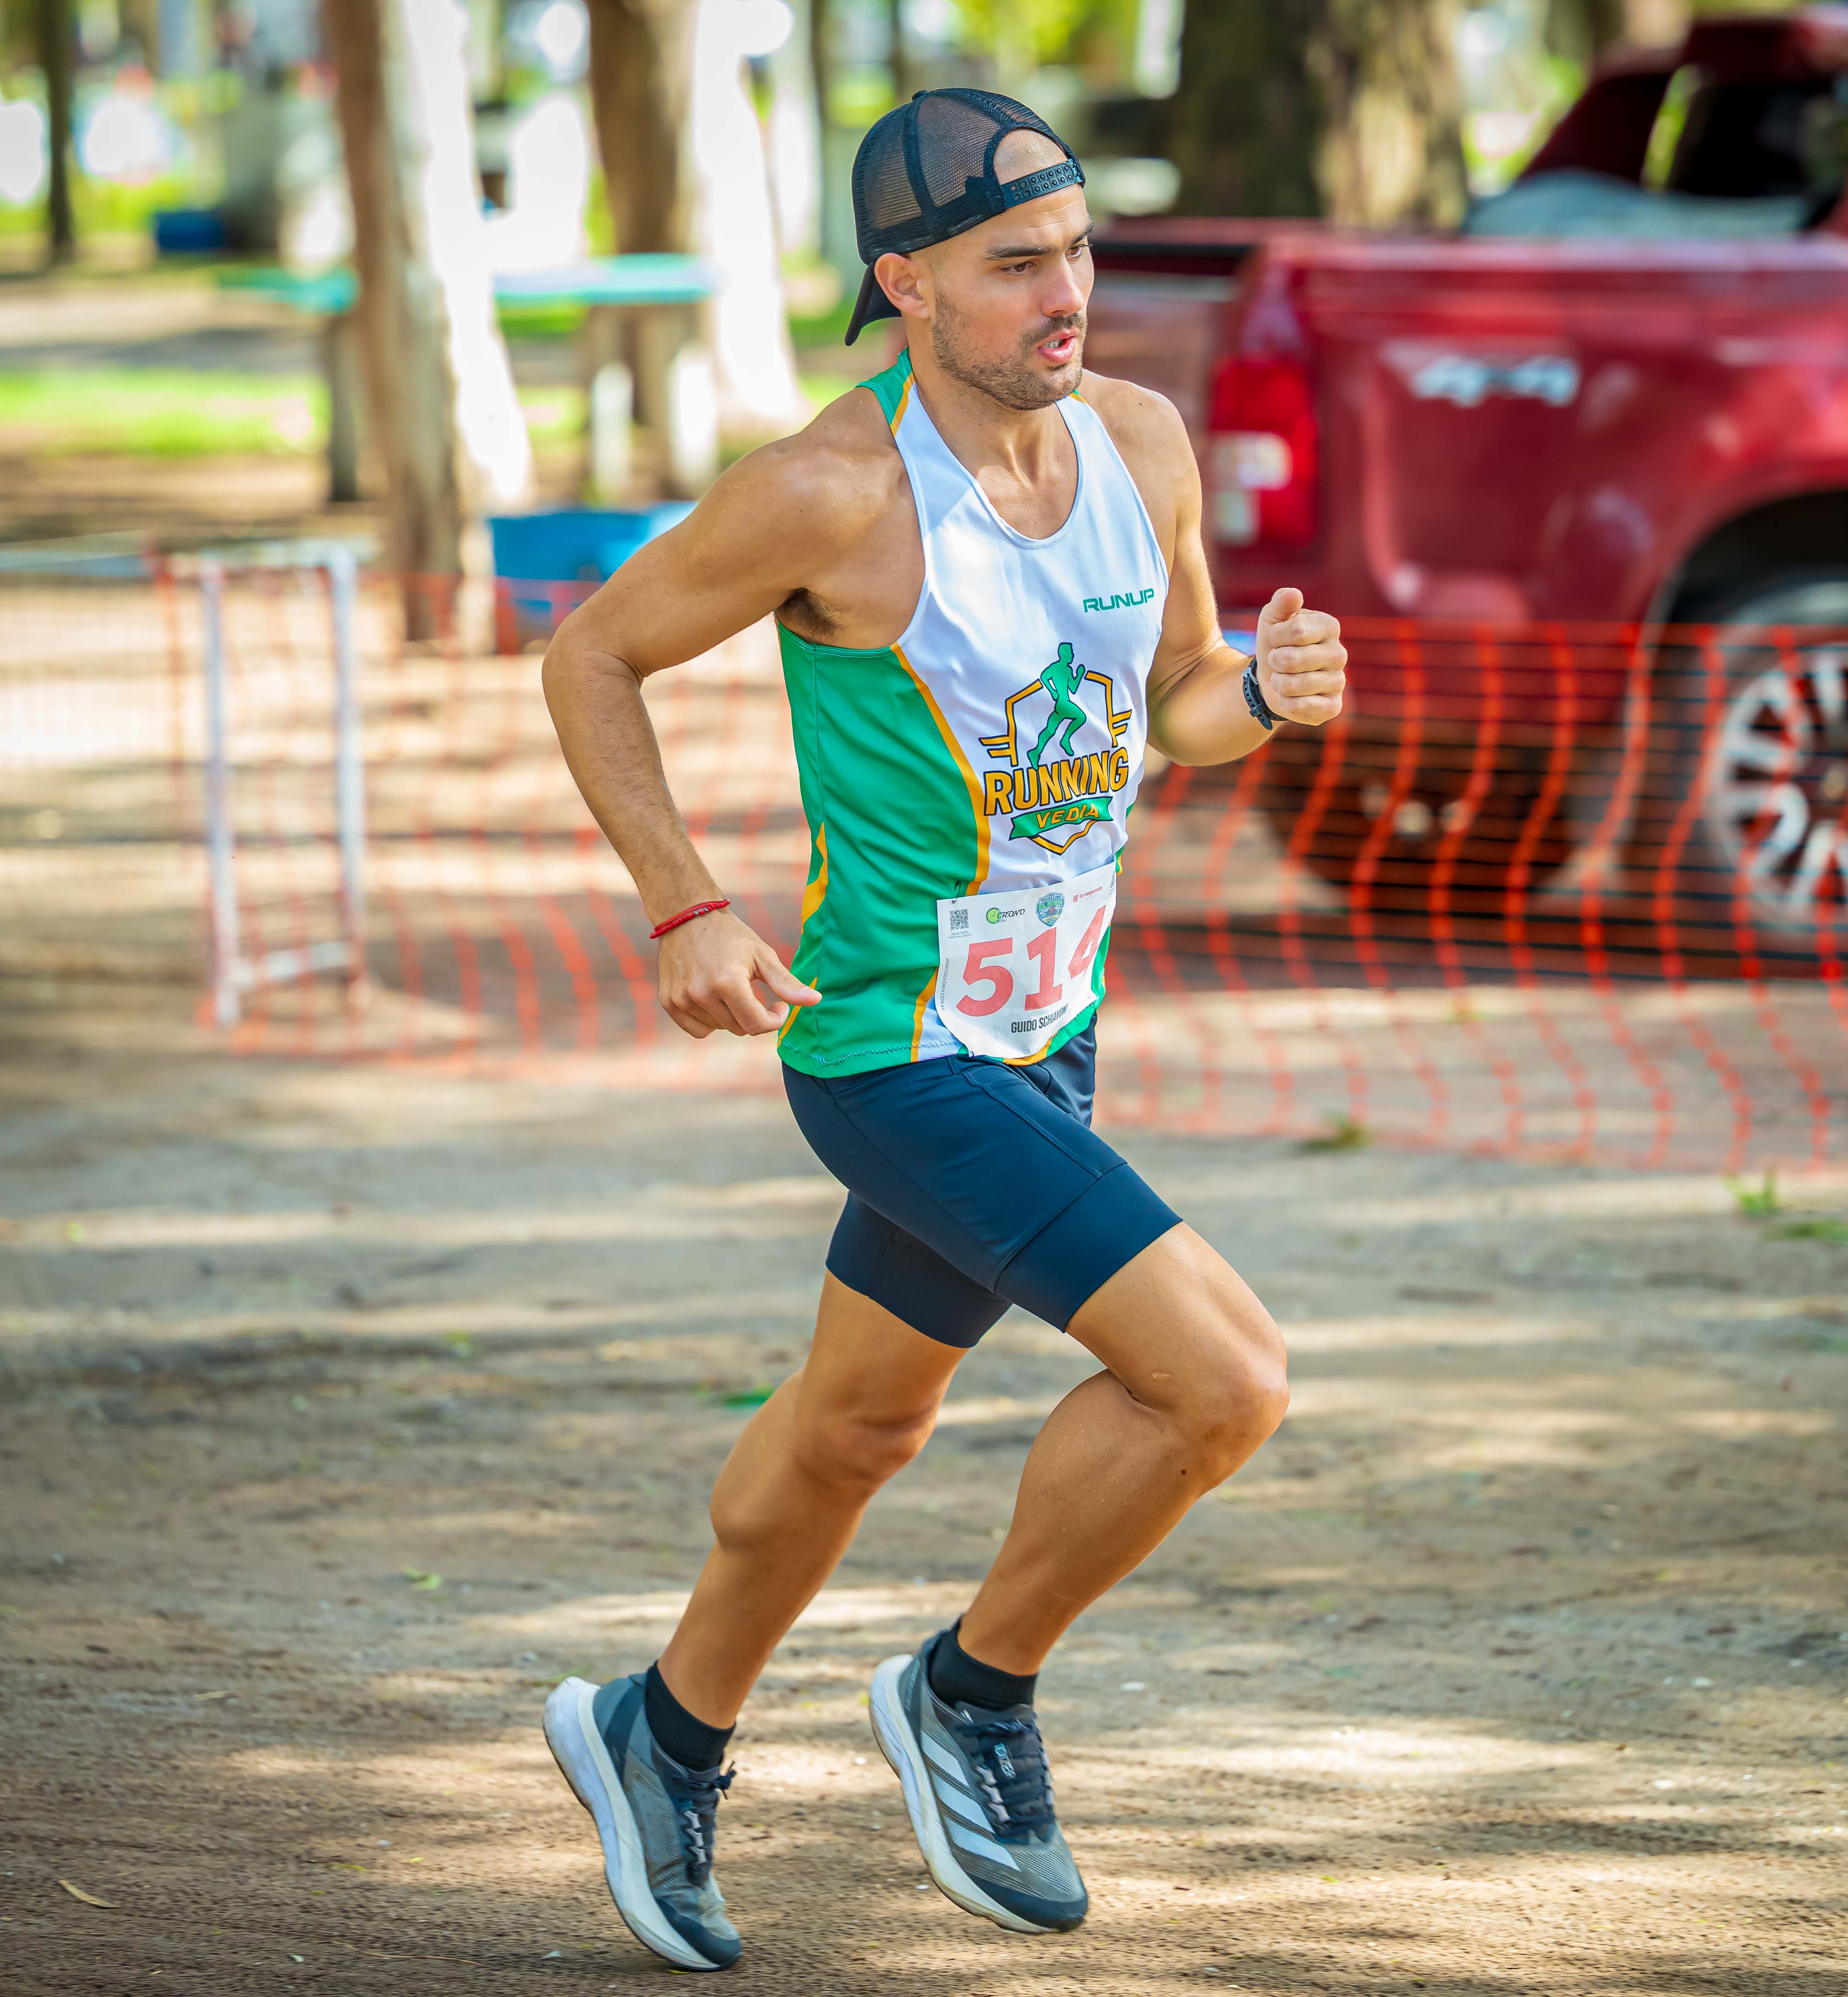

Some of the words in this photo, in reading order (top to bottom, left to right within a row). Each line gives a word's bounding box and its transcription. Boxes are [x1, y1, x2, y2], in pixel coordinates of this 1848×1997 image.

[1083, 588, 1154, 612] RUNUP
[983, 747, 1128, 816] RUNNING
[1036, 803, 1099, 828] VEDIA
[996, 909, 1025, 919] CRONO
[956, 905, 1106, 1016] 514
[1011, 1019, 1037, 1033] GUIDO
[1039, 1004, 1068, 1029] SCHIAVONI
